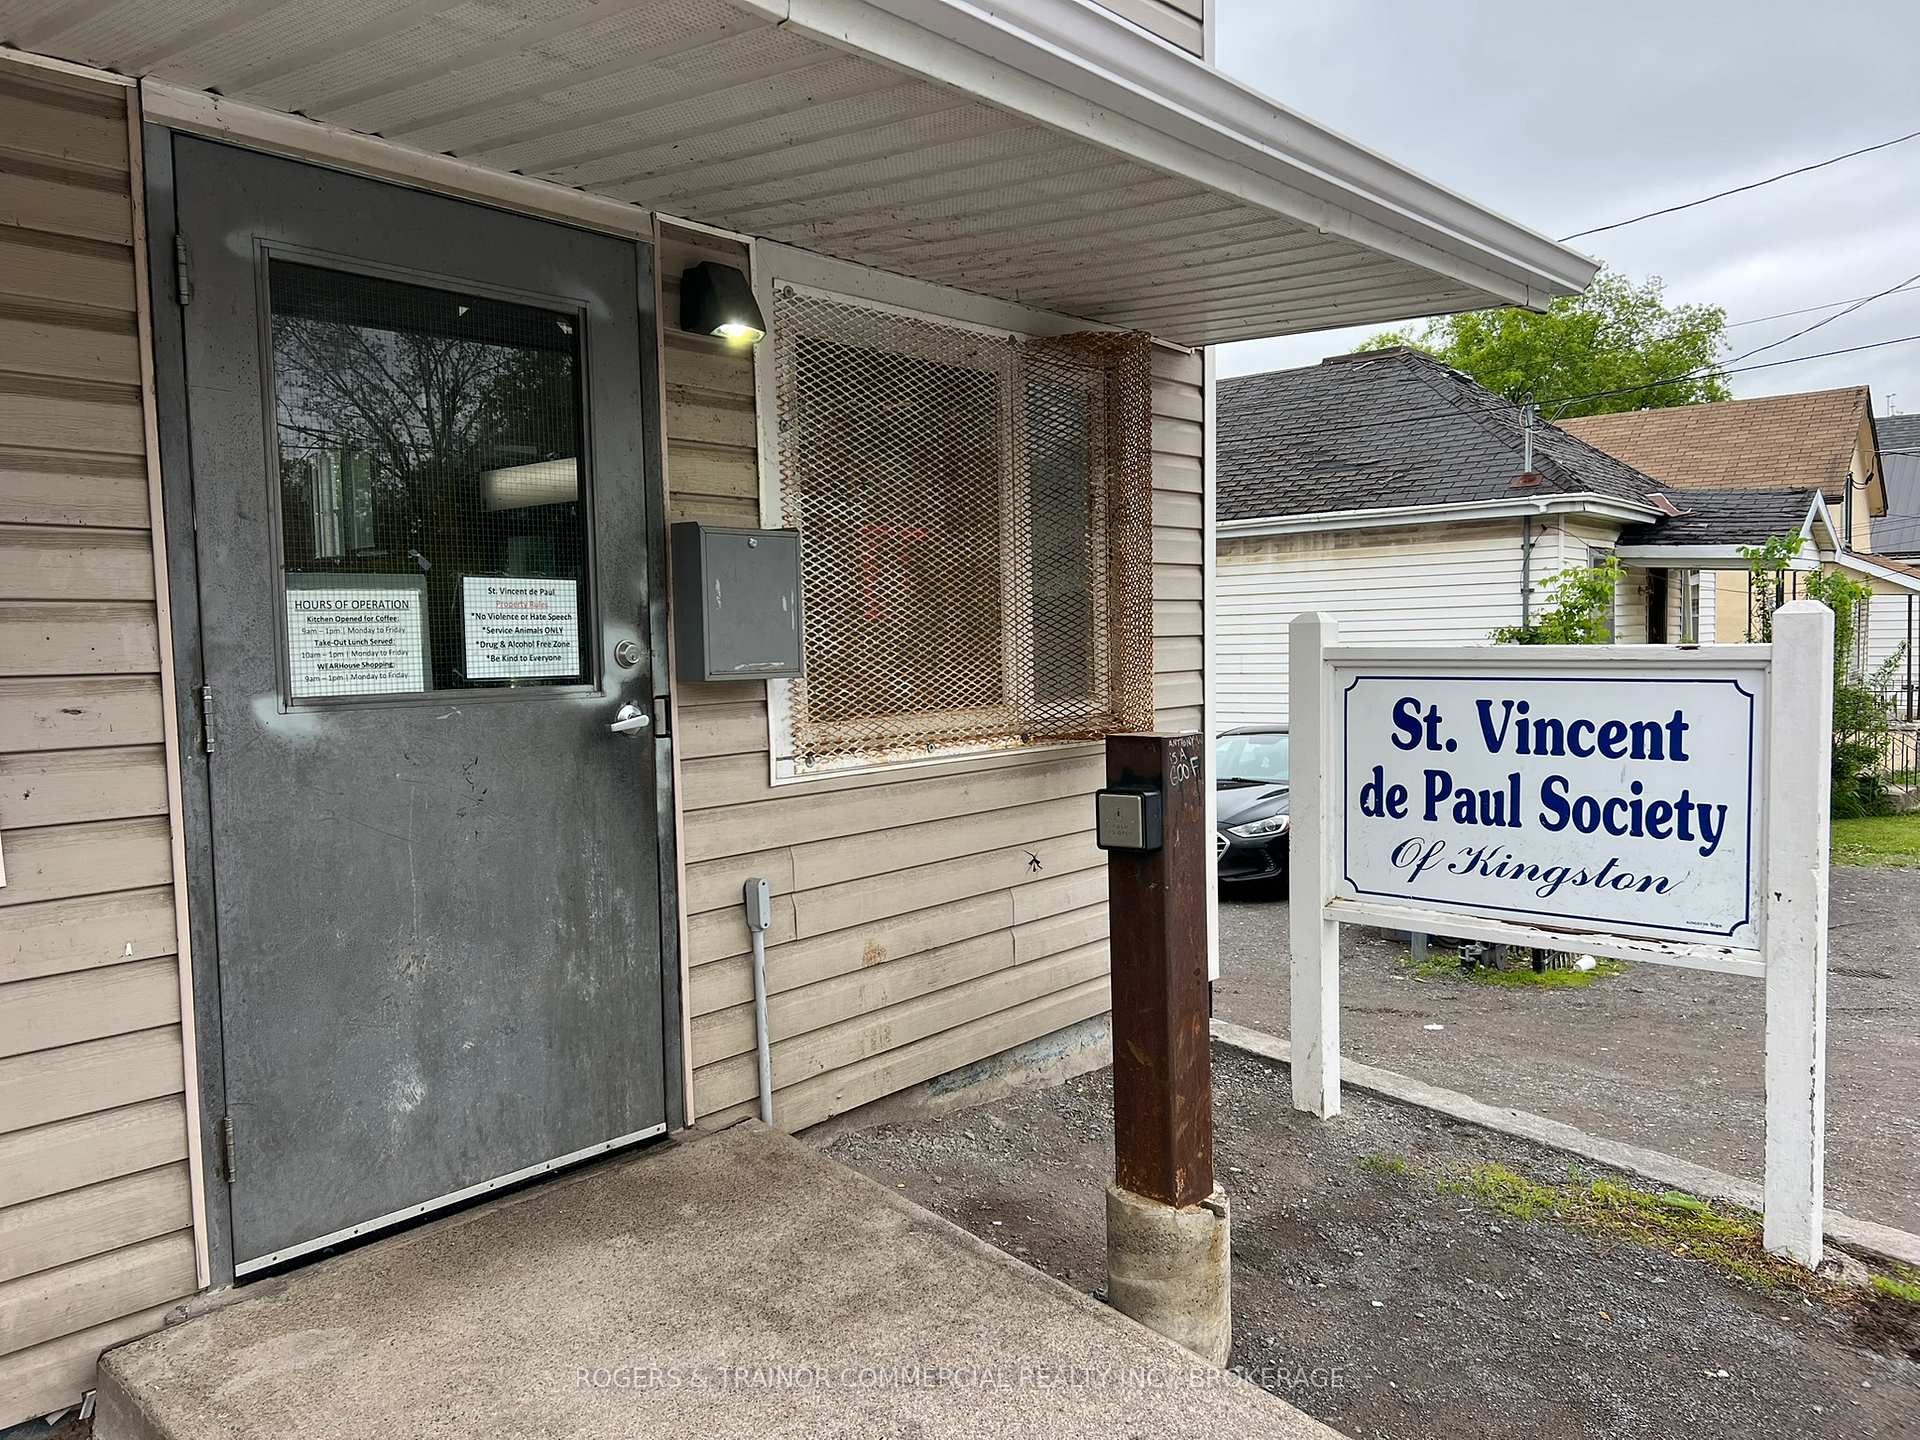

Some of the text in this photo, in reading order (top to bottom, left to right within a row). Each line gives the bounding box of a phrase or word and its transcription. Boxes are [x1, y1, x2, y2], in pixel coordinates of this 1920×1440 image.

[488, 586, 498, 594] St.
[294, 600, 410, 610] HOURS OF OPERATION
[306, 615, 334, 623] Kitchen
[335, 616, 362, 624] Opened
[488, 612, 519, 620] Violence
[548, 613, 572, 622] Speech
[514, 626, 544, 634] Animals
[544, 626, 564, 635] ONLY
[529, 654, 562, 662] Everyone
[1391, 696, 1690, 762] St. Vincent
[1170, 756, 1198, 786] GOOF
[1359, 765, 1729, 858] de Paul Society
[1390, 836, 1691, 899] Of Kingston
